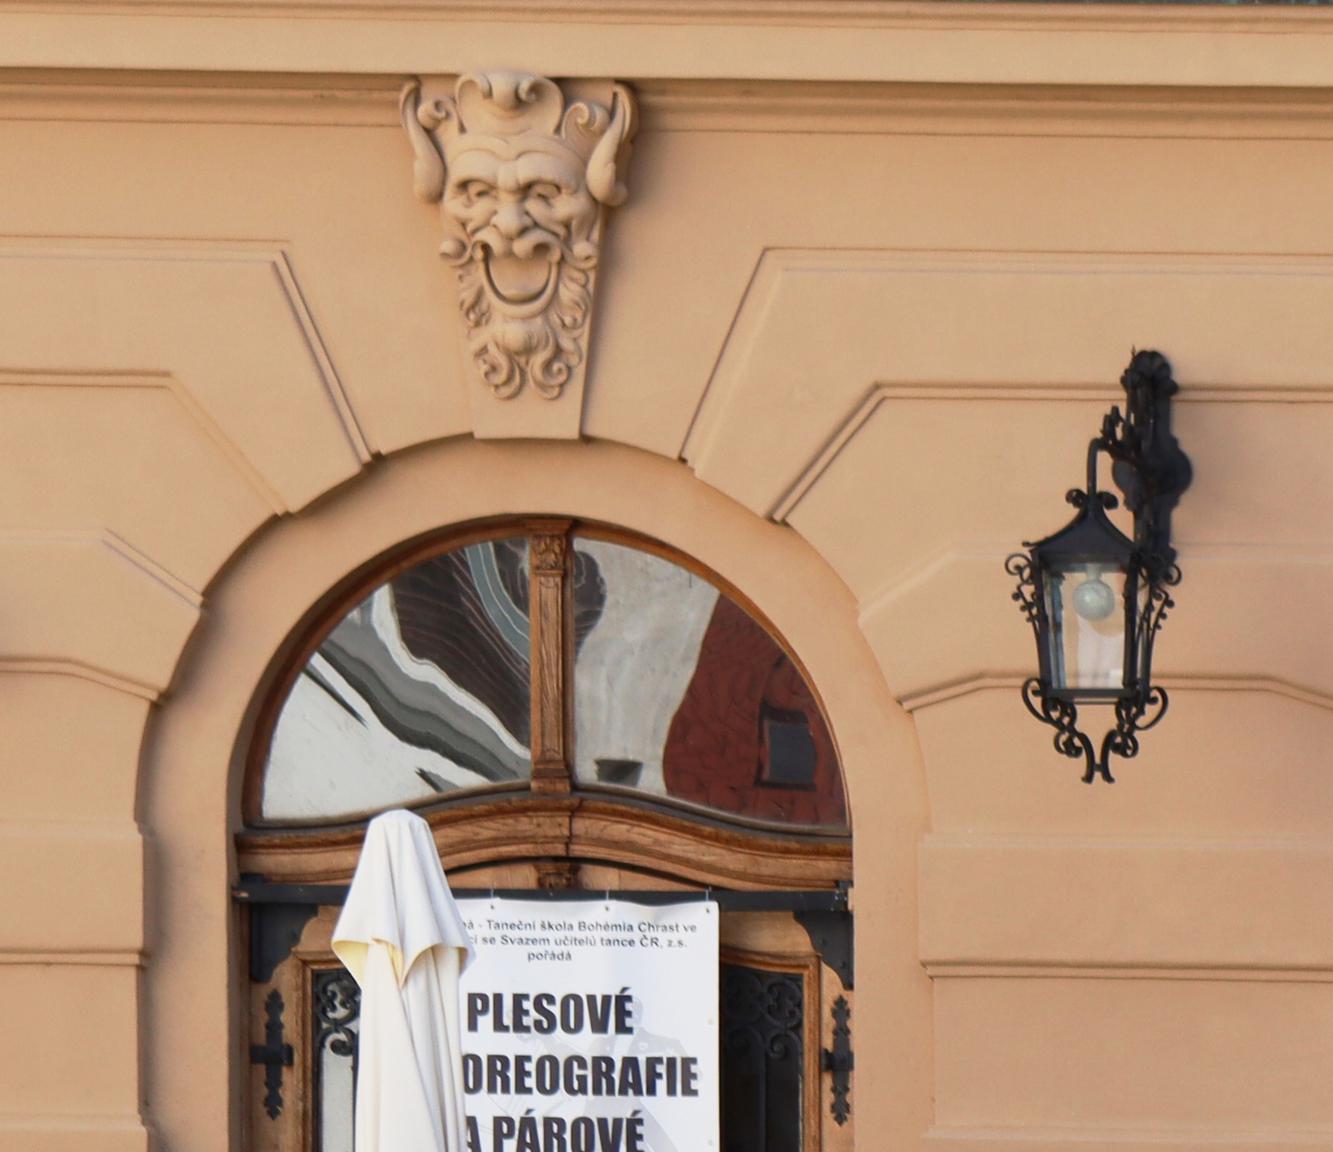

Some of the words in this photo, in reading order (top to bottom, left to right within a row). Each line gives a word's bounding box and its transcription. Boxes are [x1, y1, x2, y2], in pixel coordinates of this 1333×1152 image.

[487, 920, 536, 931] Taneční
[540, 920, 574, 932] škola
[638, 922, 680, 933] Chrast
[683, 925, 697, 933] ve
[482, 937, 496, 945] se
[500, 935, 551, 946] Svazem
[600, 937, 635, 947] tance
[527, 950, 572, 962] pořádá
[467, 987, 634, 1035] PLESOVÉ
